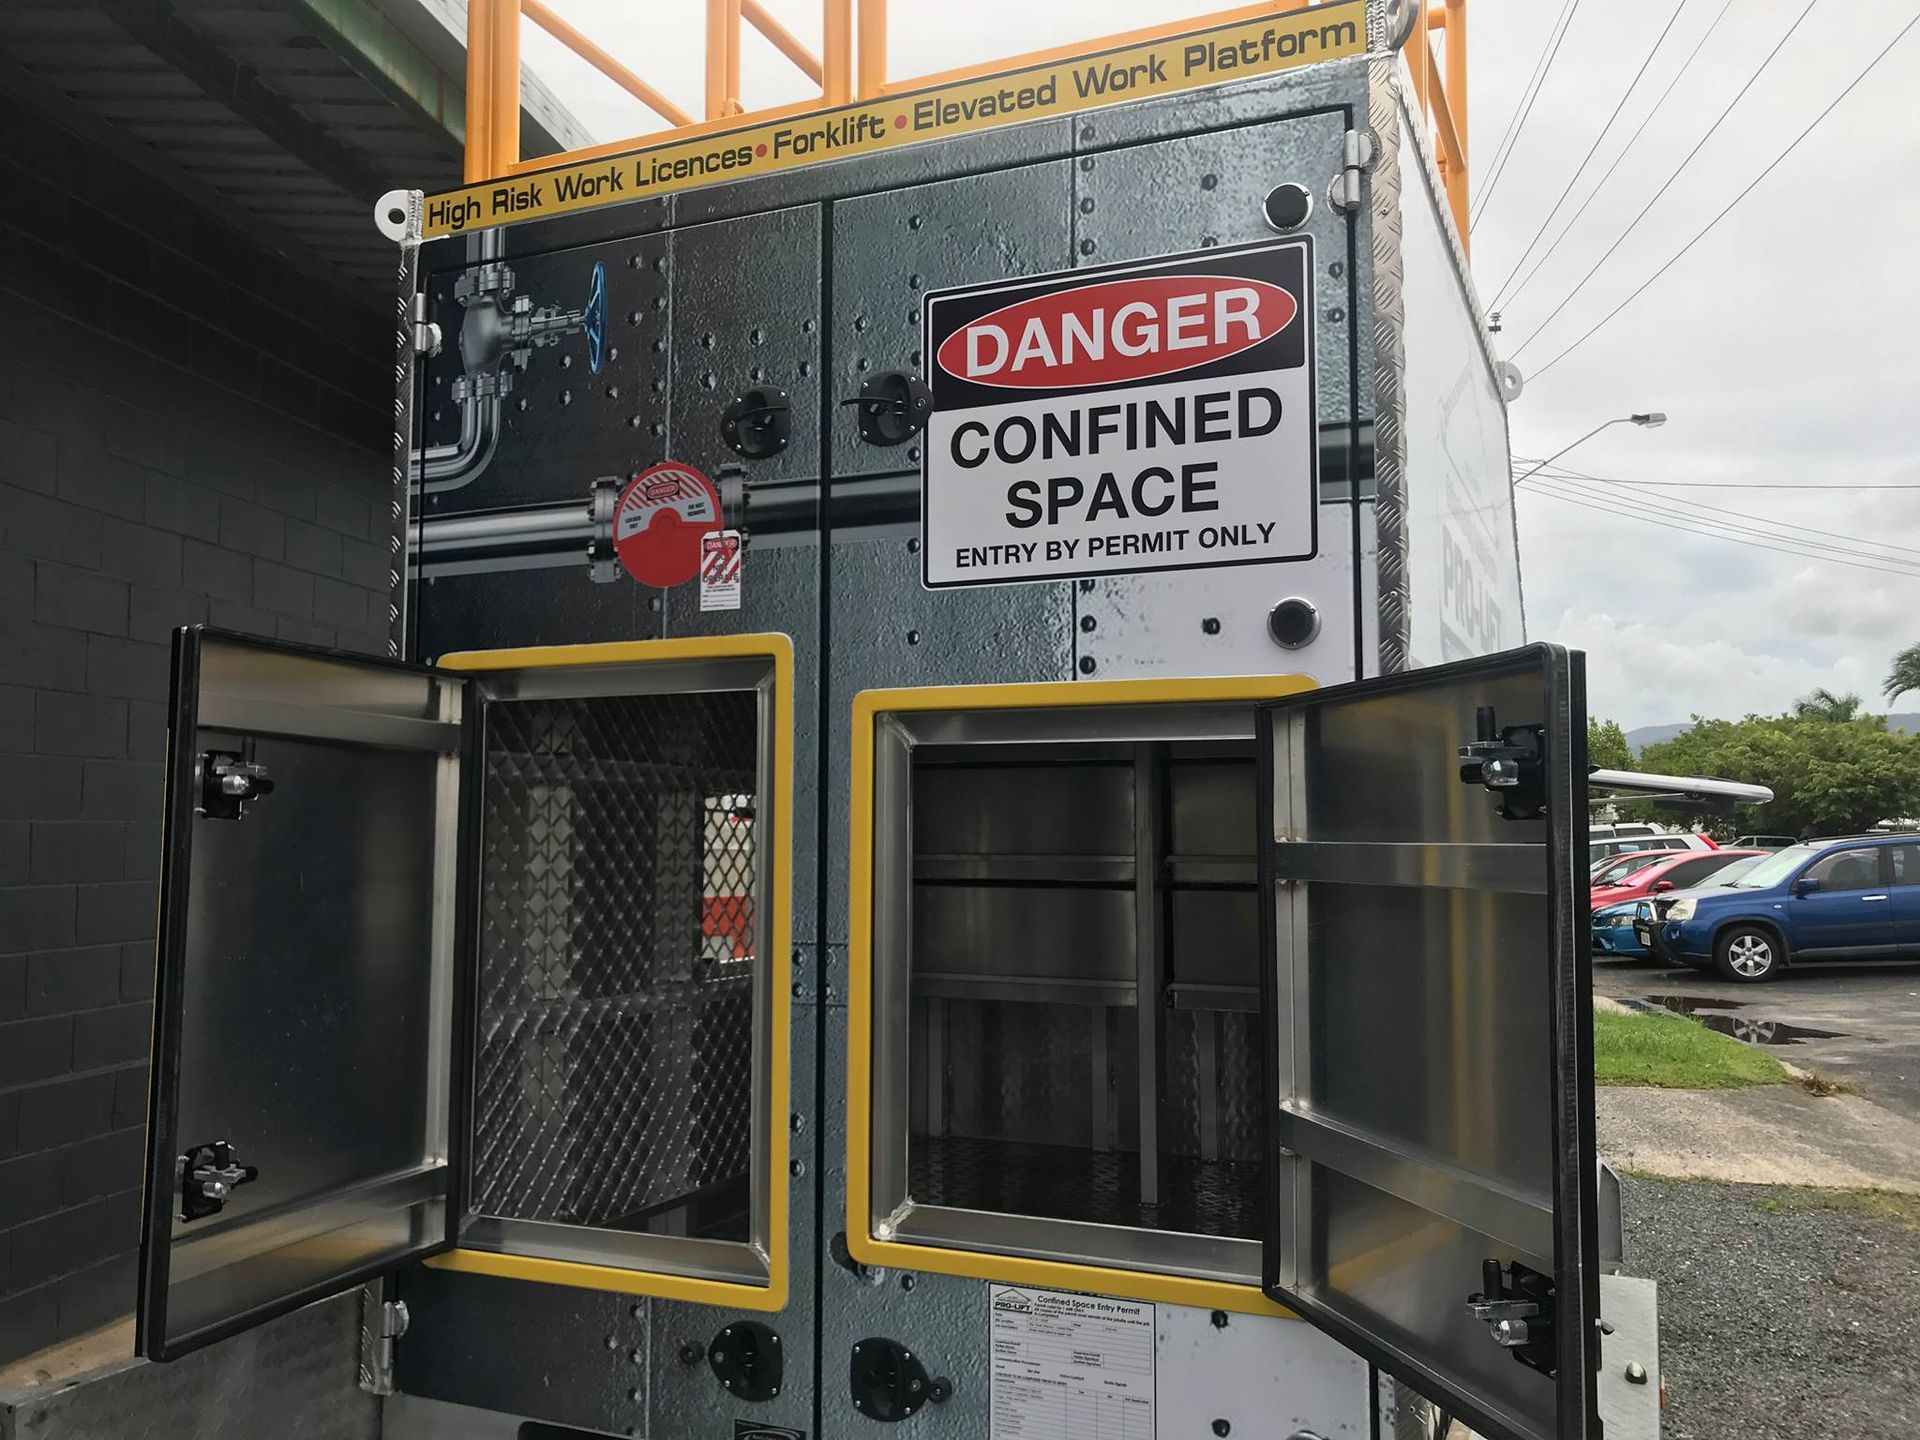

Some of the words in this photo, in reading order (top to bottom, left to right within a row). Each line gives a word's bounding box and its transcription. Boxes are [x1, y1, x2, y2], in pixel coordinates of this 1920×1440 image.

[429, 199, 480, 230] High
[492, 182, 542, 216] Risk
[554, 168, 623, 202] Work
[636, 143, 753, 188] Licences
[773, 115, 886, 160] Forklift
[914, 76, 1057, 130] Elevated
[1073, 55, 1167, 98] Work
[1184, 19, 1356, 76] Platform
[966, 287, 1262, 377] DANGER
[950, 387, 1283, 469] CONFINED
[650, 485, 676, 498] DANGER
[1005, 461, 1219, 528] SPACE
[956, 543, 1037, 568] ENTRY
[1046, 539, 1080, 560] BY
[1088, 529, 1190, 558] PERMIT
[1198, 522, 1277, 548] ONLY
[995, 1301, 1031, 1311] PRO-LIFT
[1037, 1295, 1070, 1307] Confined
[1072, 1299, 1095, 1310] Space
[1097, 1303, 1115, 1313] Entry
[1117, 1305, 1140, 1315] Permit
